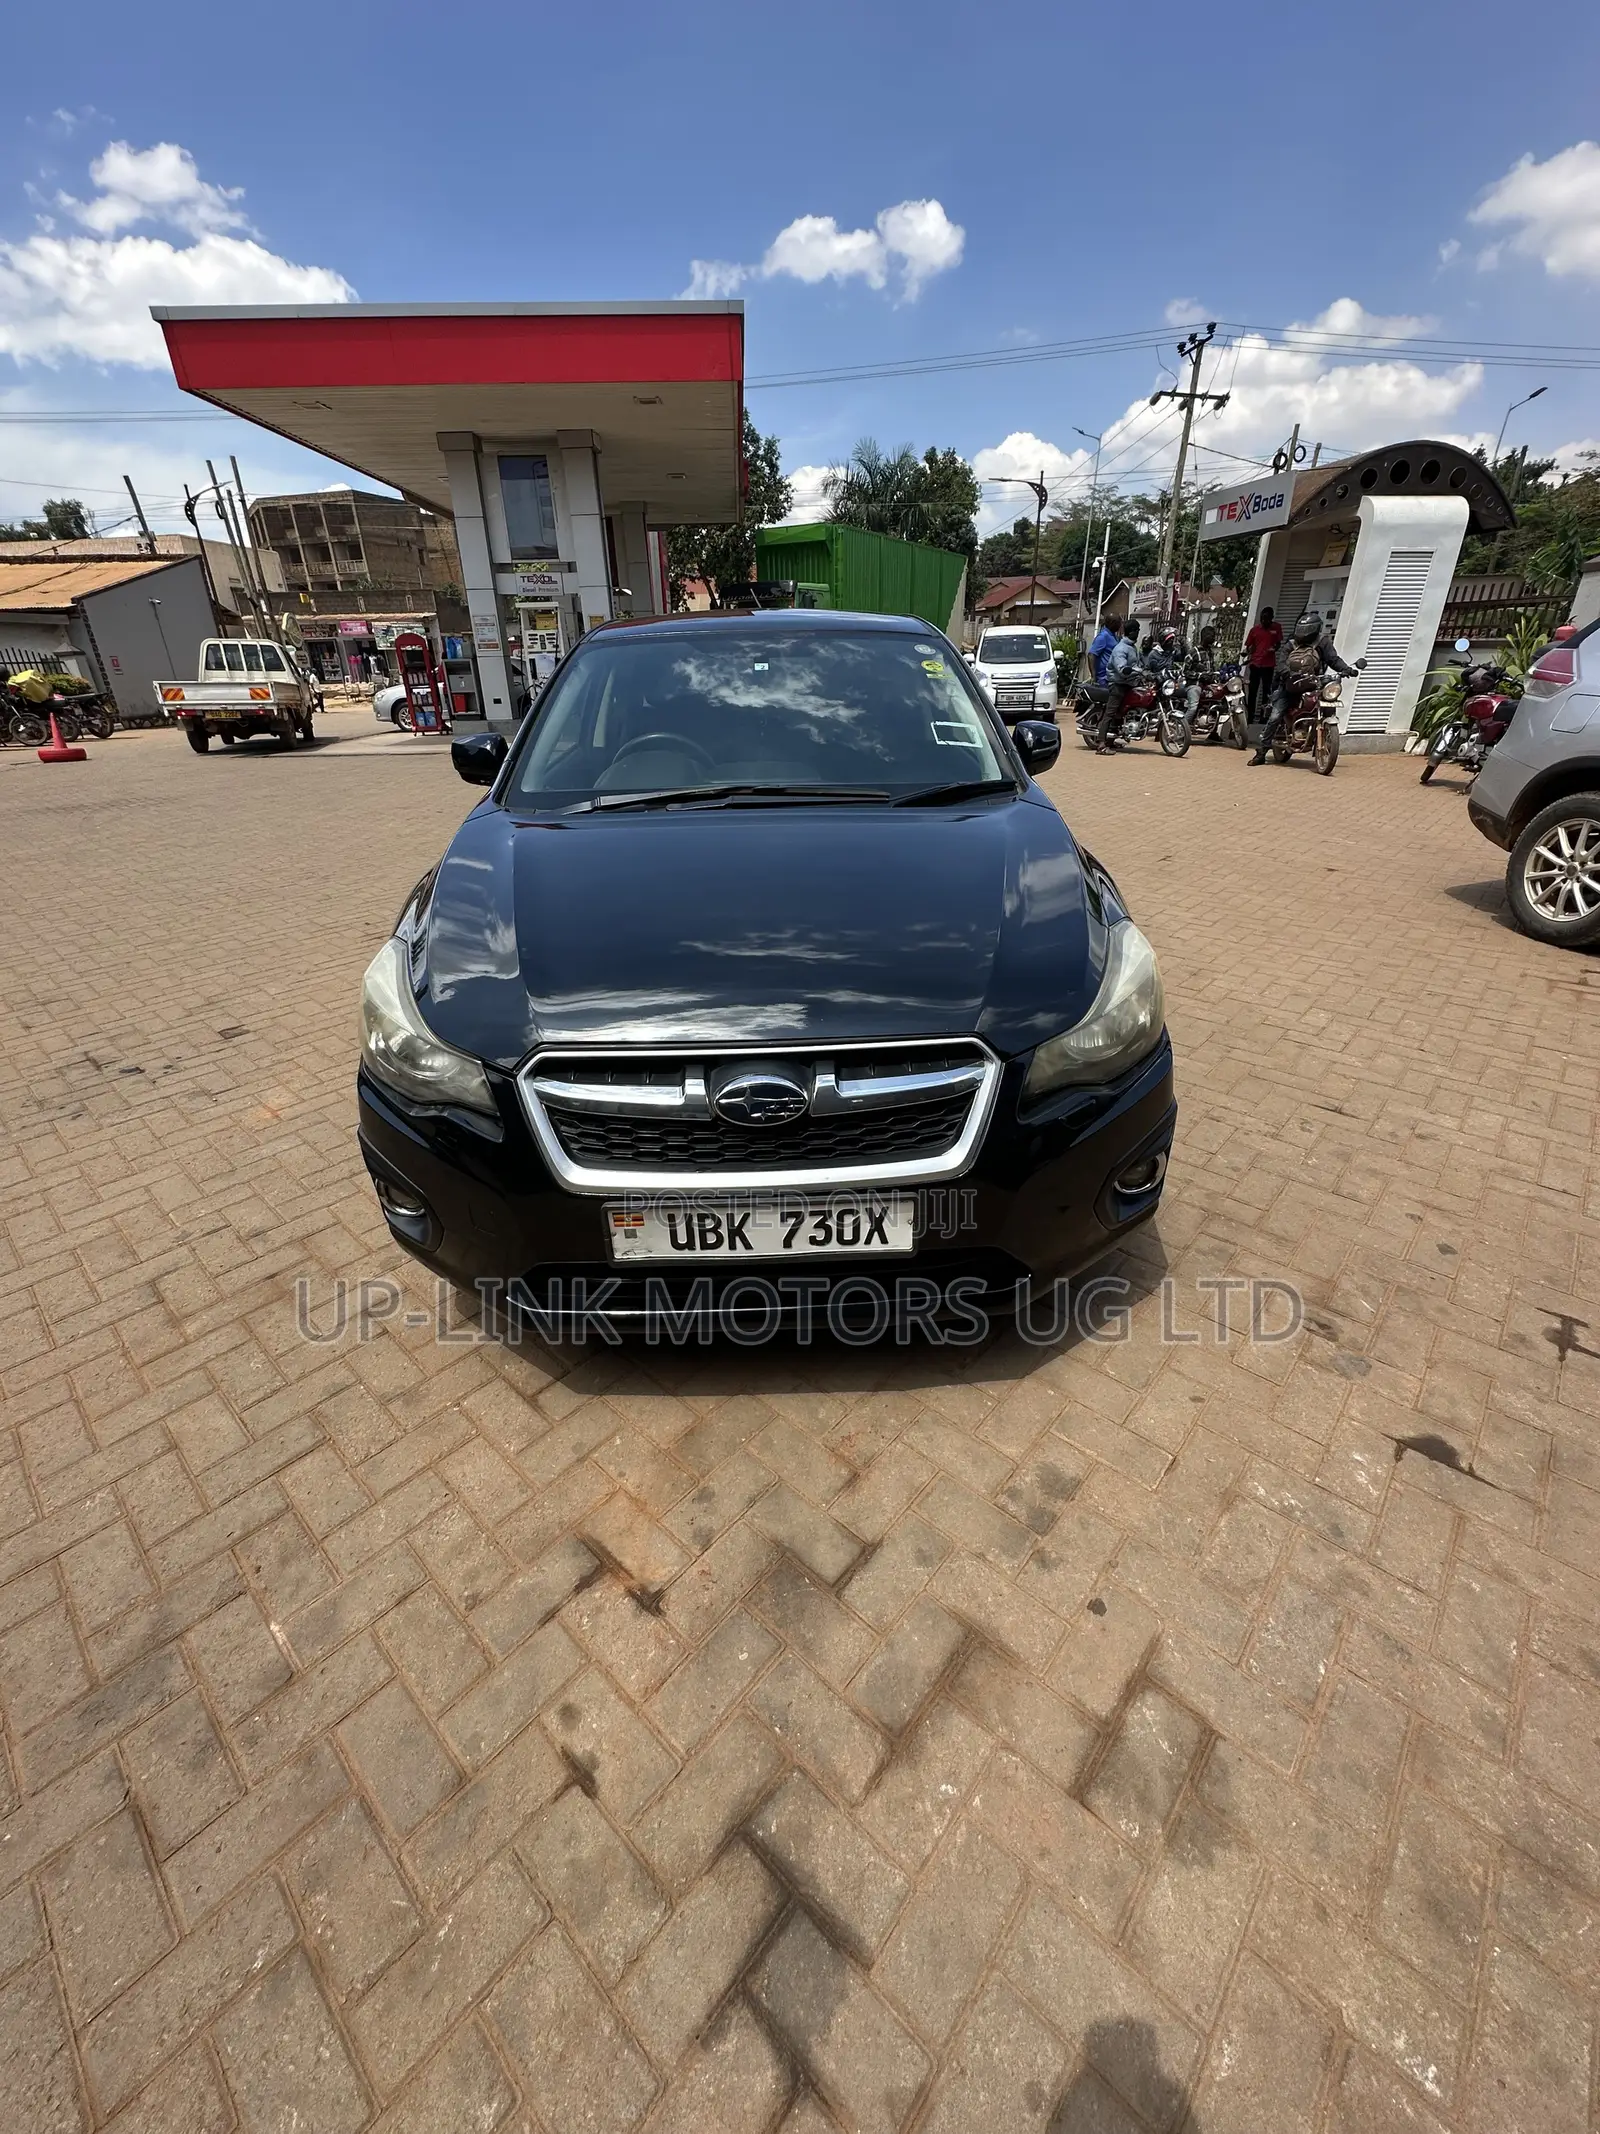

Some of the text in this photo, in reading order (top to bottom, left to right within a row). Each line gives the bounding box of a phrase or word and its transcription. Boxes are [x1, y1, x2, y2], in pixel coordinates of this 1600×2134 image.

[520, 573, 558, 584] TEXOL
[1135, 582, 1158, 594] KABIR
[667, 1206, 889, 1251] UBK 730X
